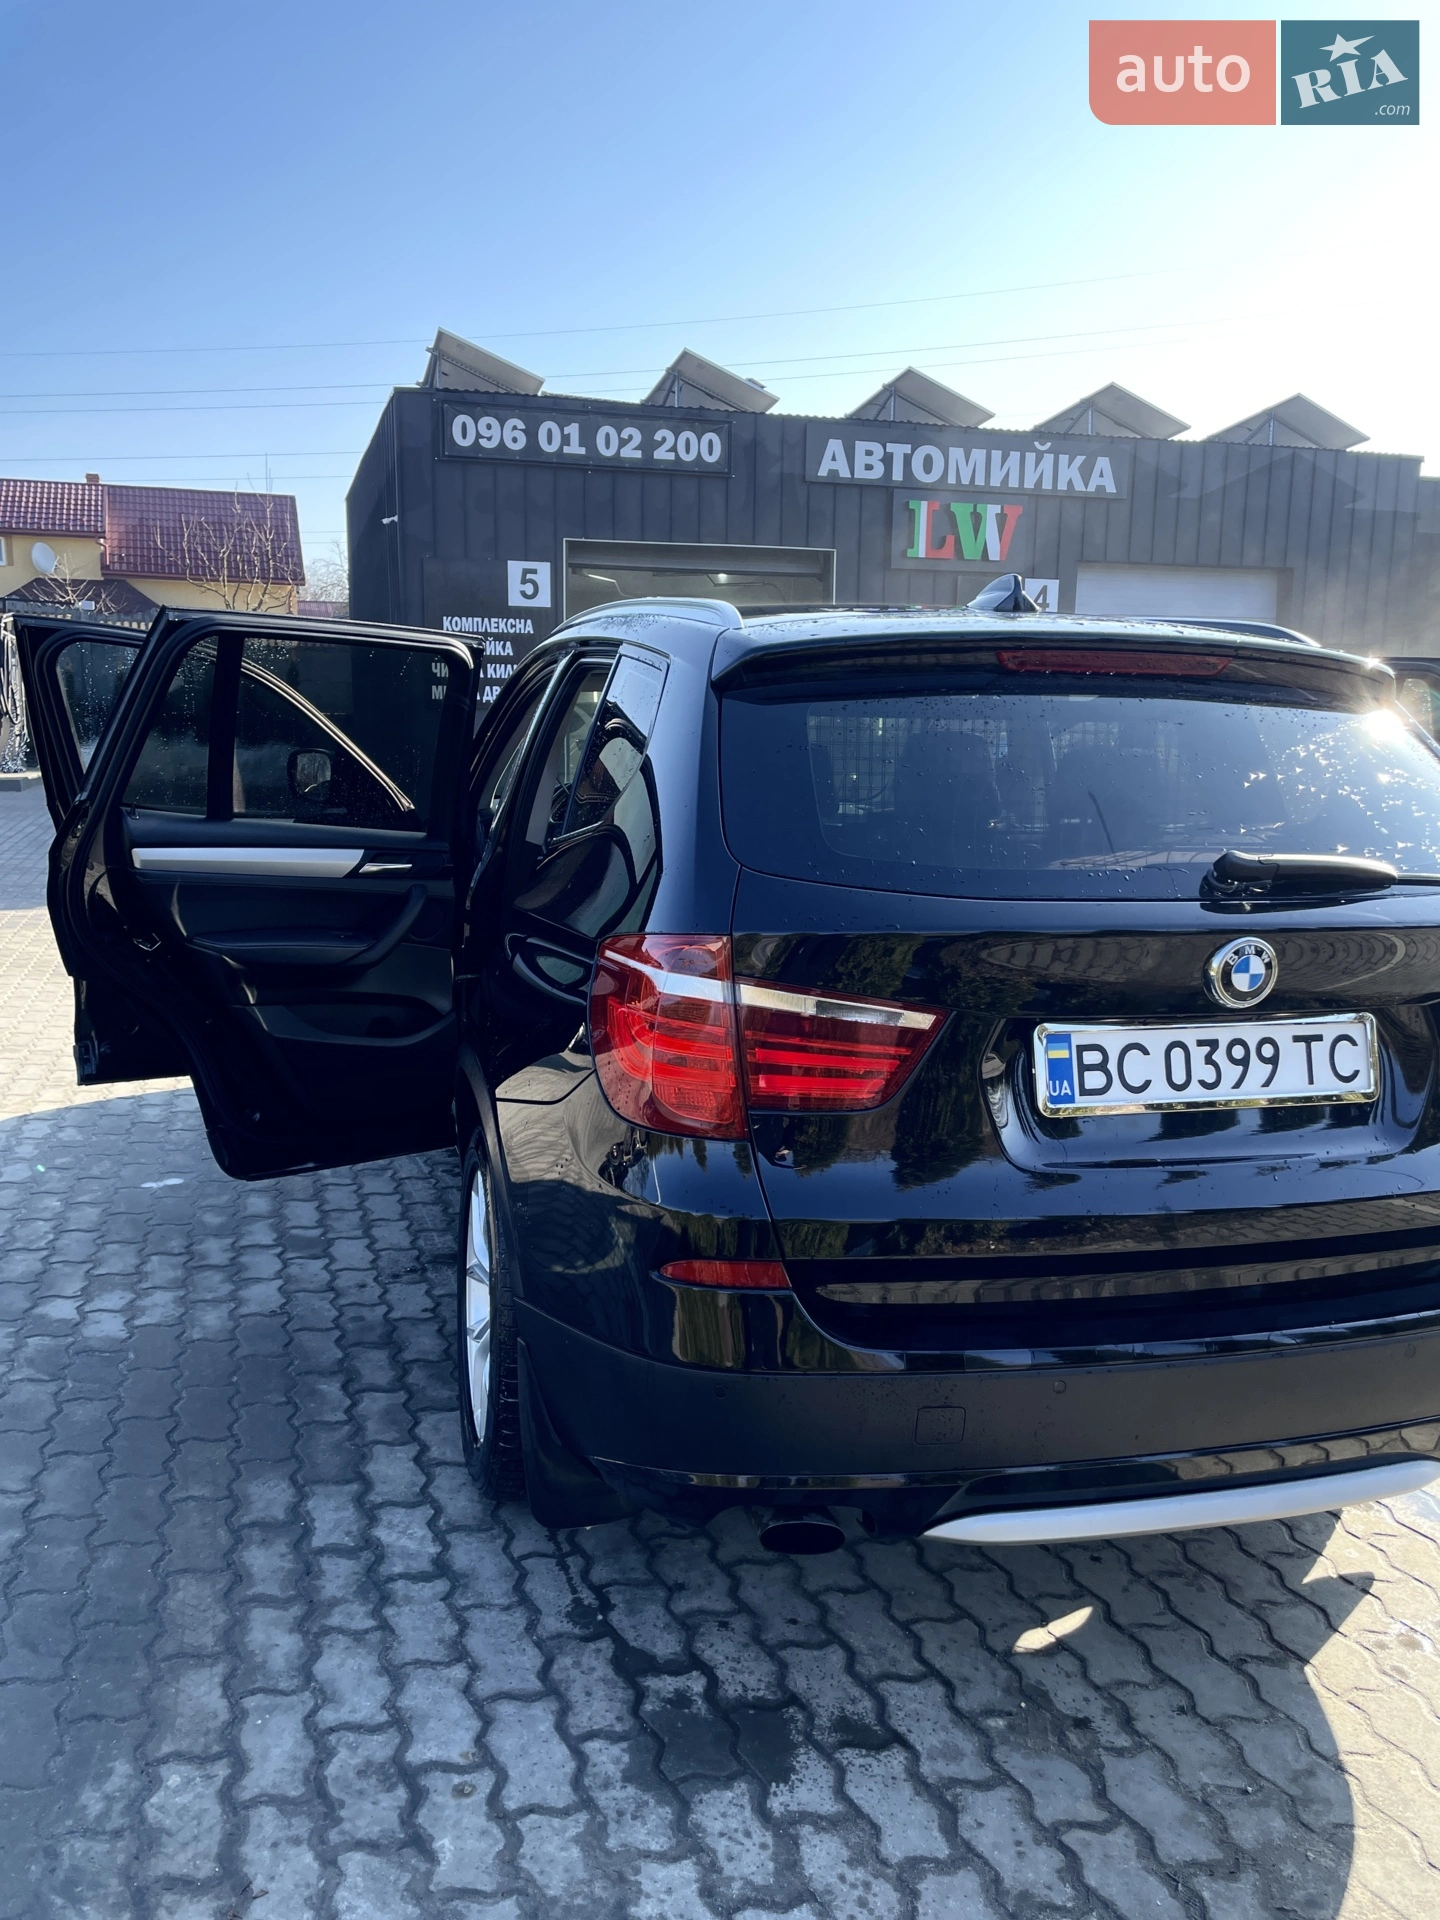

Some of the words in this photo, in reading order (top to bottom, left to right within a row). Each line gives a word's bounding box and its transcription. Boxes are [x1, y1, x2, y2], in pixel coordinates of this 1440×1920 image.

[452, 414, 527, 450] 096
[538, 421, 586, 454] 01
[596, 425, 642, 458] 02
[653, 429, 722, 462] 200
[816, 438, 1117, 493] АВТОМИЙКА
[907, 499, 1023, 561] LW
[519, 568, 540, 600] 5
[1033, 585, 1050, 612] 4
[442, 616, 534, 634] КОМПЛЕКСНА
[483, 637, 514, 656] ЙКА
[1226, 945, 1270, 966] BMW
[1075, 1041, 1153, 1097] BC
[1164, 1036, 1281, 1092] 0399
[1292, 1033, 1361, 1086] TC
[1049, 1079, 1072, 1097] UA
